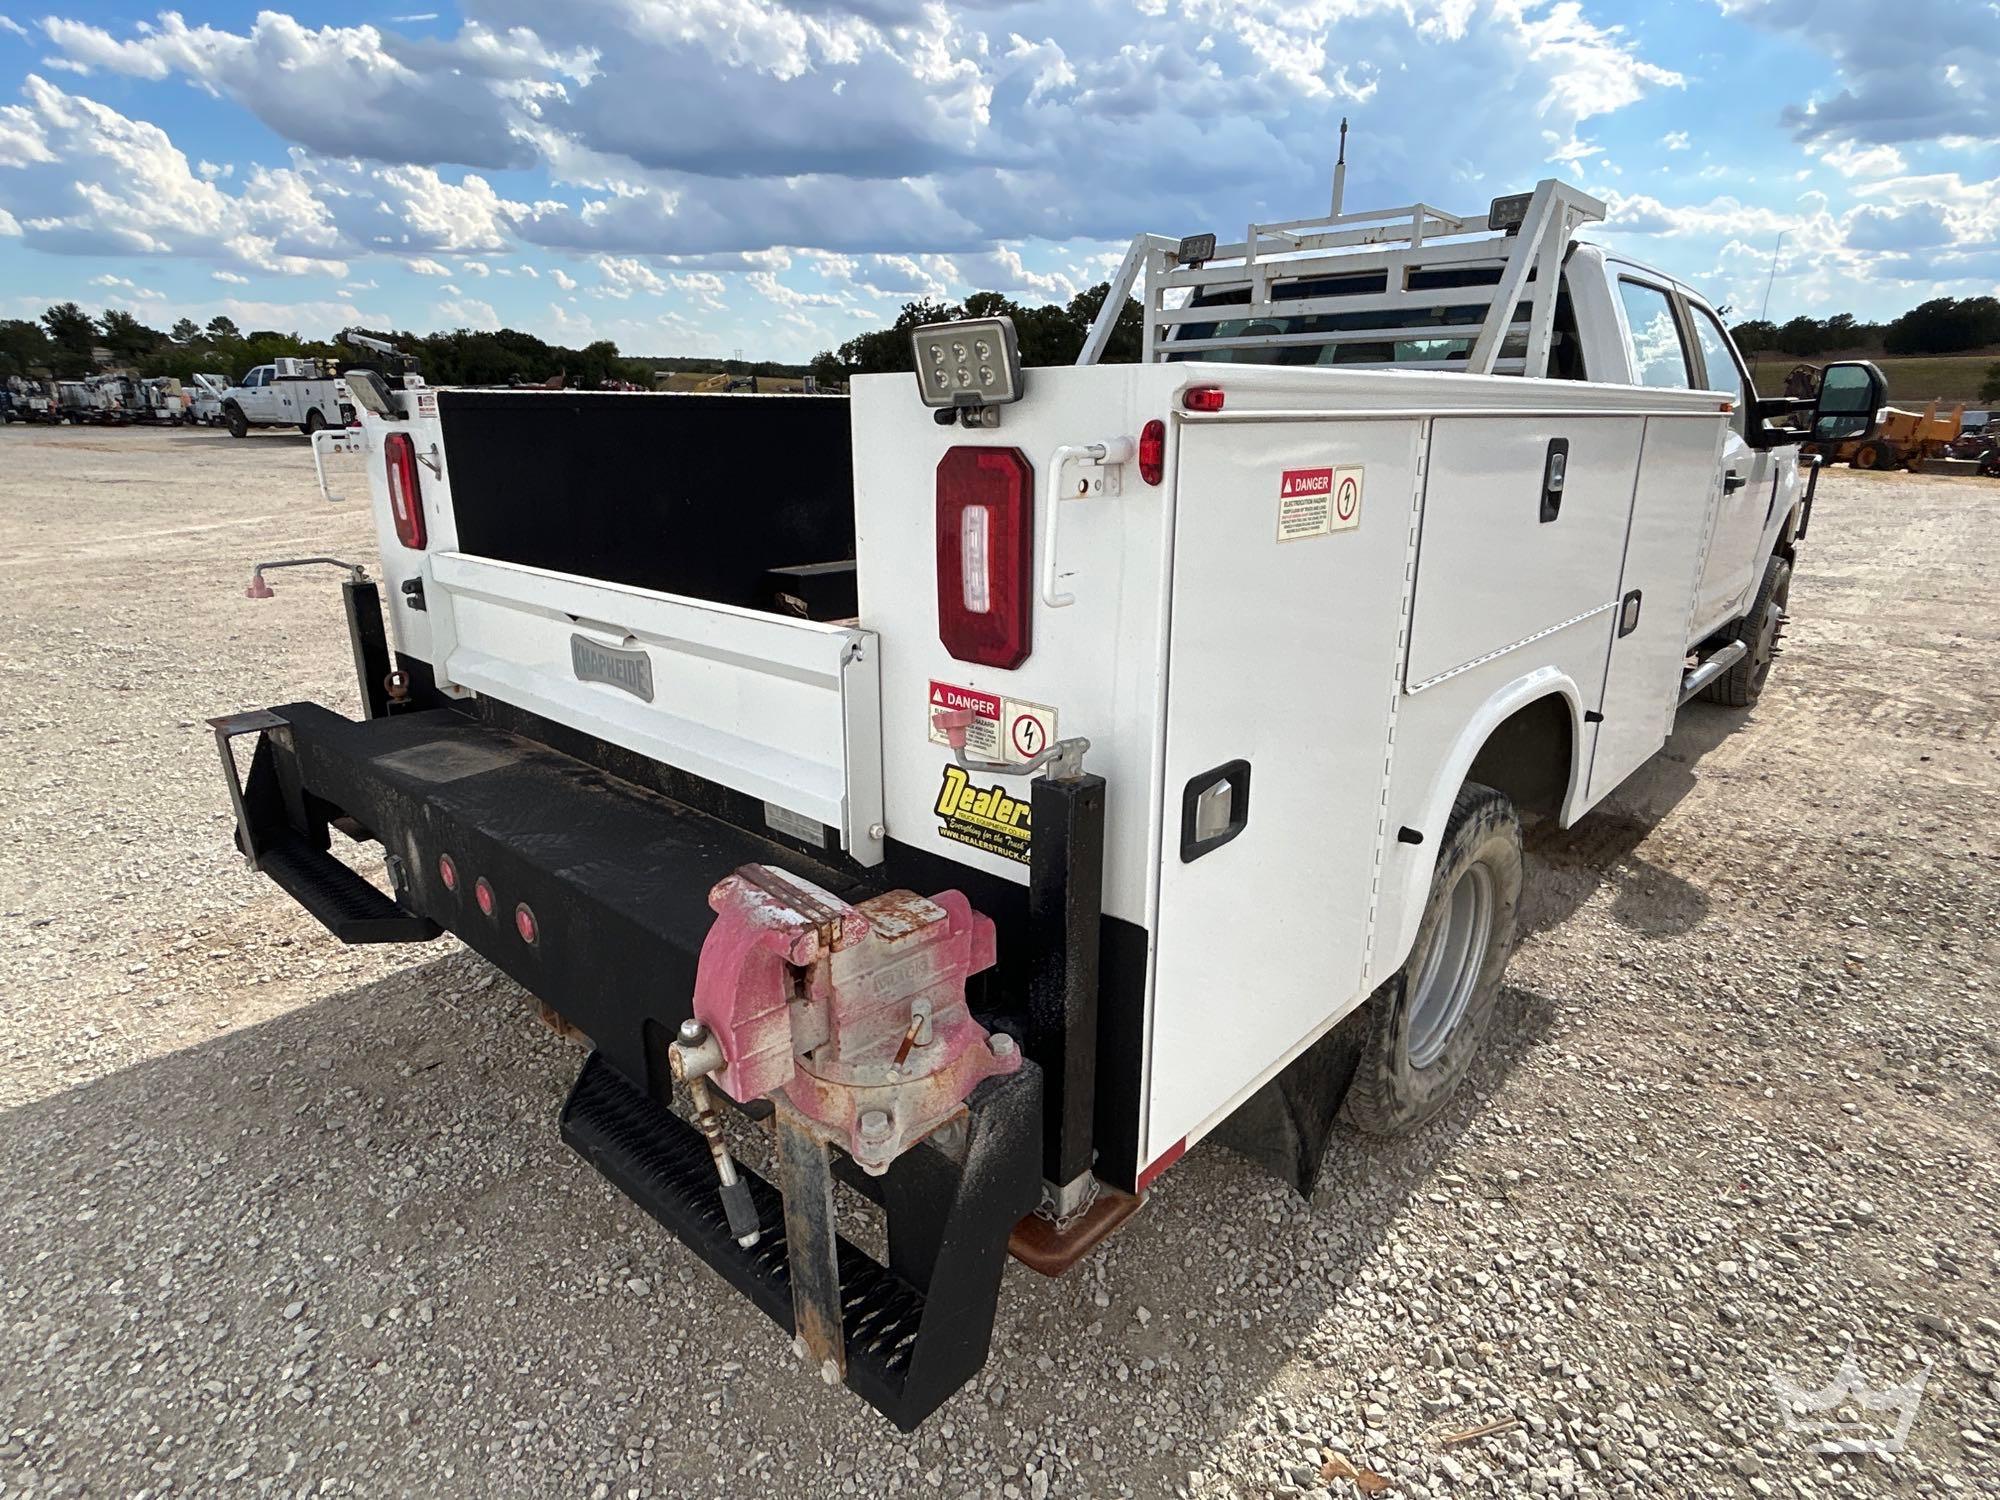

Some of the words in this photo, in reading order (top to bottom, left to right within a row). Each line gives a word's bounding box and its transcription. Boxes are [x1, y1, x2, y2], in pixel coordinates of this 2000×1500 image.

[1295, 476, 1329, 492] DANGER
[947, 692, 995, 715] DANGER
[940, 827, 1032, 864] WWW.DEALERSTRUCK.CO
